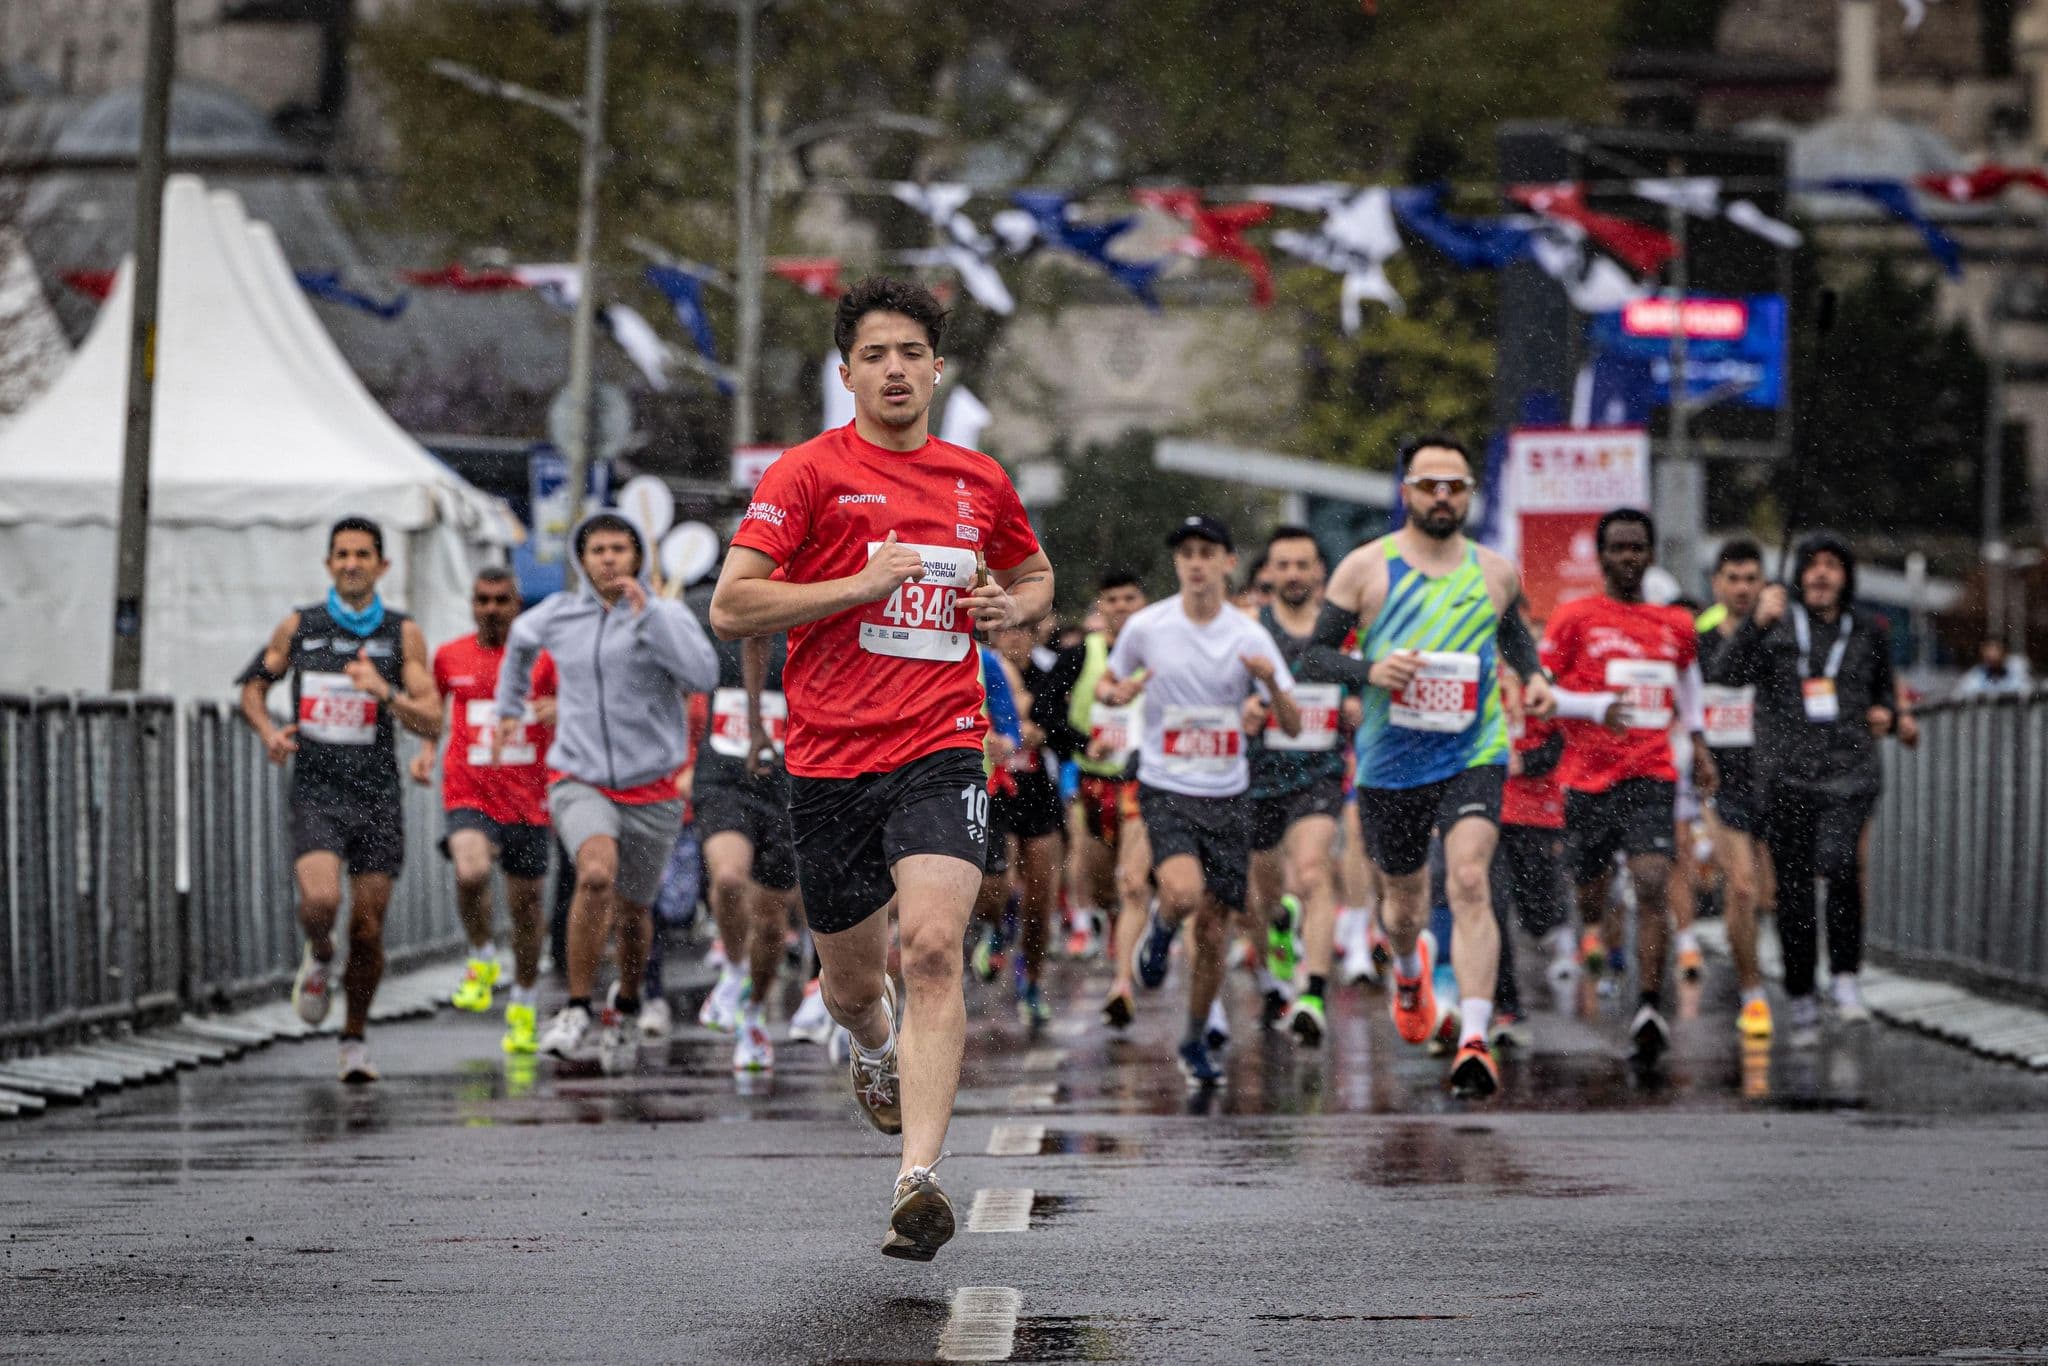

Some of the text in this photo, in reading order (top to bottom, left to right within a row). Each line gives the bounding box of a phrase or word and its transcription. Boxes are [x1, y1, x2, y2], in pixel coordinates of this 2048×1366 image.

[838, 493, 887, 503] SPORTIVE
[883, 585, 957, 630] 4348
[1401, 679, 1464, 713] 4388
[961, 783, 988, 828] 10
